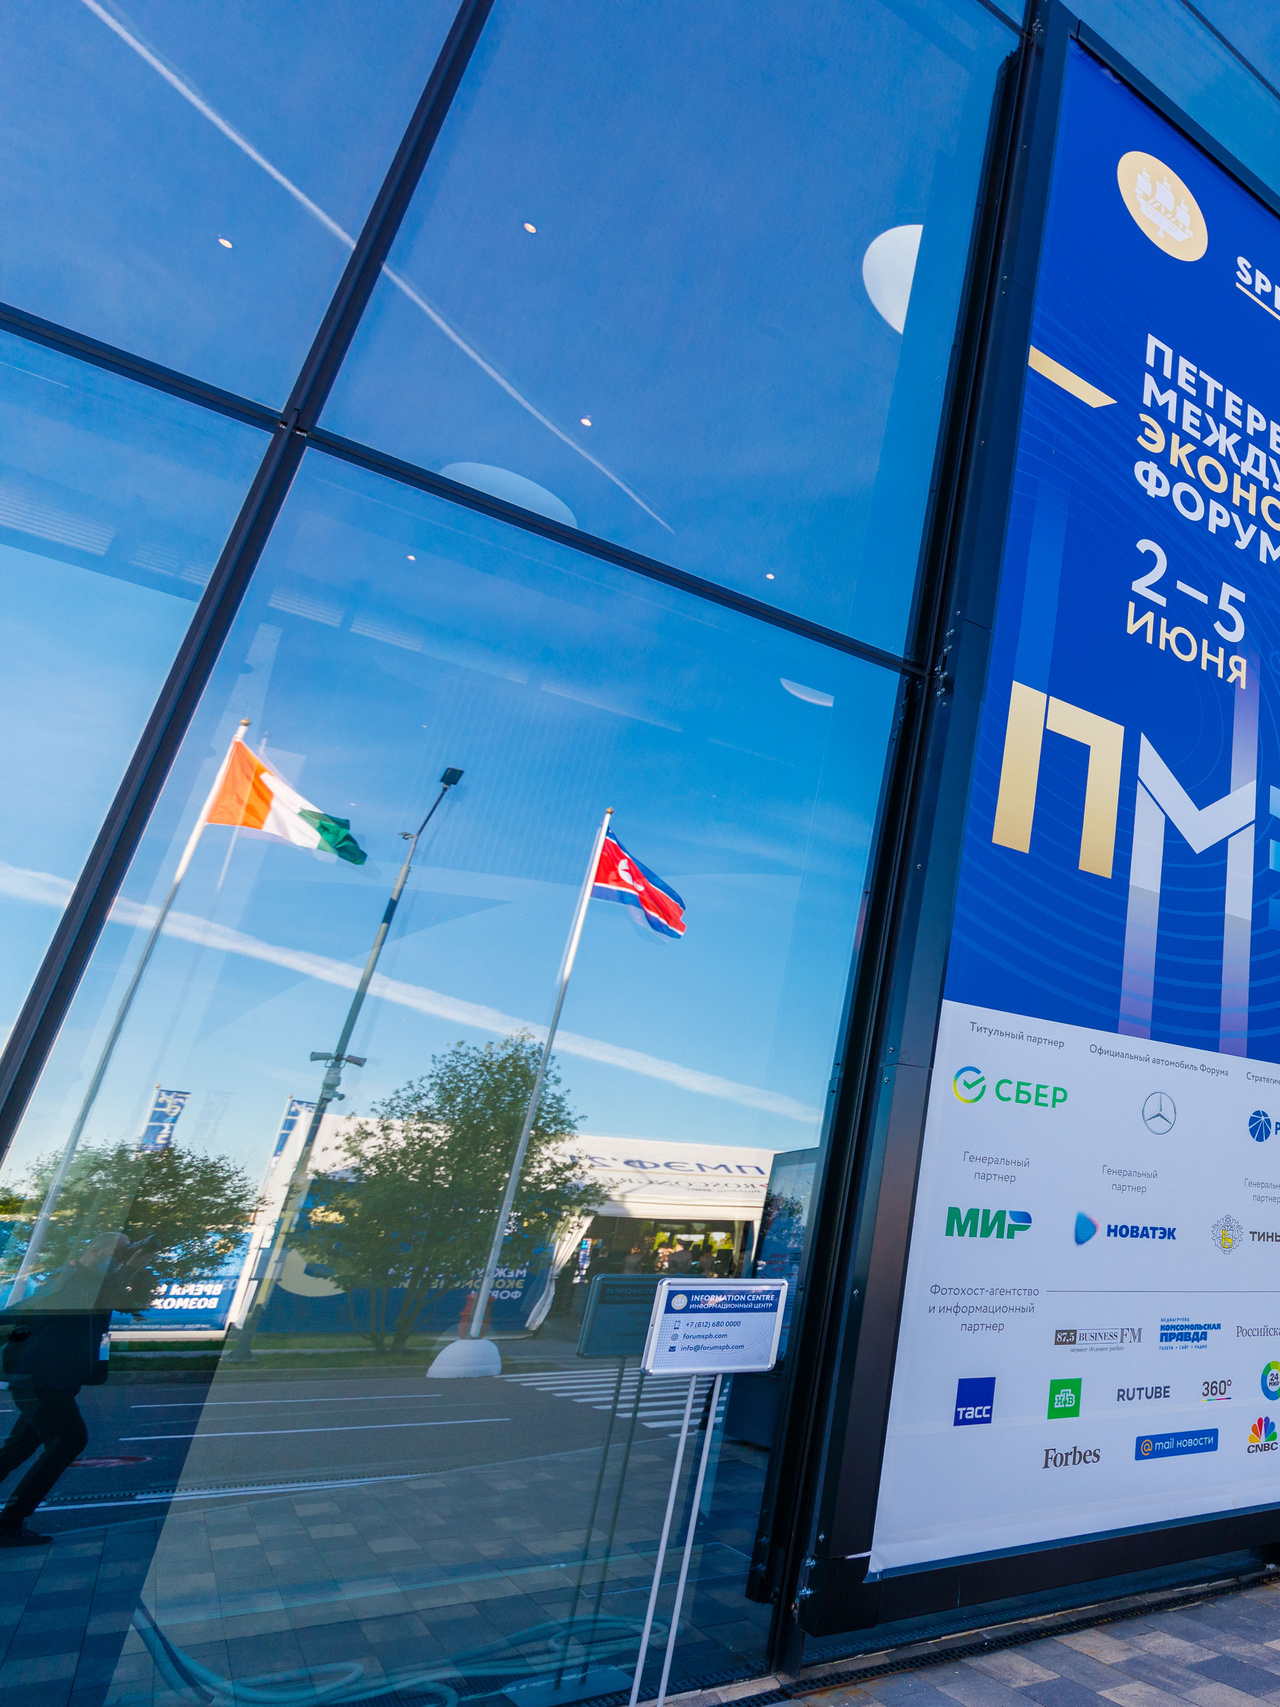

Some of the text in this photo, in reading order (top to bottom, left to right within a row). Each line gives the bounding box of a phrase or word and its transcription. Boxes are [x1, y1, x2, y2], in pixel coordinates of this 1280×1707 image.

[1126, 601, 1248, 690] ИЮНЯ
[969, 1021, 1064, 1049] Титульный партнер
[1089, 1044, 1229, 1077] Официальный автомобиль Форума
[995, 1078, 1068, 1109] СБЕР
[963, 1151, 1030, 1169] Генеральный
[974, 1170, 1016, 1185] партнер
[1102, 1165, 1158, 1180] Генеральный
[1111, 1182, 1147, 1195] партнер
[1252, 1193, 1280, 1205] партнер
[945, 1206, 1032, 1239] МИР
[1106, 1224, 1177, 1240] НОВАТЭК
[929, 1284, 1040, 1297] Фотохост-агентство
[928, 1302, 1035, 1316] и информационный
[694, 1321, 711, 1329] (812)
[960, 1321, 1005, 1334] партнер
[1160, 1323, 1221, 1331] КОМСОМОЛЬСКАЯ
[1056, 1327, 1143, 1344] 87,5 BUSINESS FM
[1159, 1331, 1208, 1343] ПРАВДА
[681, 1344, 744, 1352] info@forumspb.com
[1269, 1372, 1279, 1382] 24
[1054, 1388, 1076, 1407] НТВ
[1117, 1386, 1171, 1402] RUTUBE
[1176, 1435, 1214, 1448] новости
[1247, 1441, 1279, 1454] CNBC
[1042, 1446, 1101, 1469] Forbes
